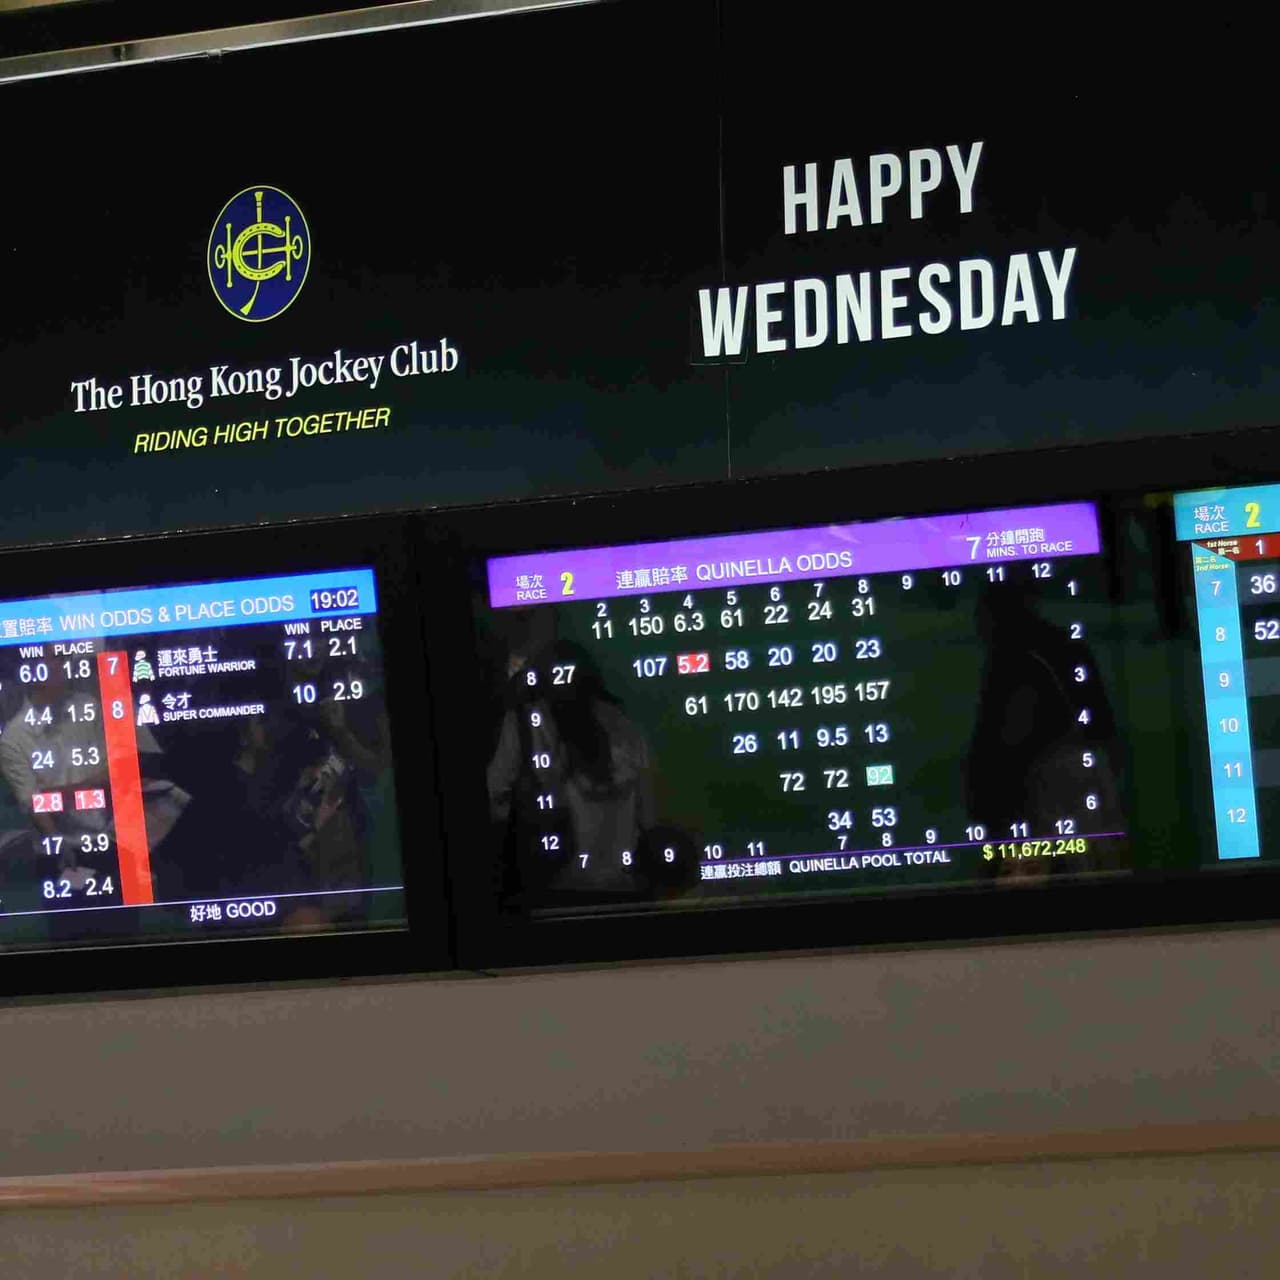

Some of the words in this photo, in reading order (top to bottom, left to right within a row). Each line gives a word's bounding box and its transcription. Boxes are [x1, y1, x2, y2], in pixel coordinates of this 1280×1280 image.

[783, 141, 984, 235] HAPPY
[699, 247, 1076, 357] WEDNESDAY
[71, 377, 123, 412] The
[130, 374, 203, 409] Hong
[210, 365, 282, 400] Kong
[285, 350, 385, 396] Jockey
[390, 338, 458, 377] Club
[134, 427, 208, 453] RIDING
[214, 420, 269, 444] HIGH
[275, 407, 390, 438] TOGETHER
[1245, 502, 1260, 527] 2
[986, 528, 1045, 547] 分鐘開跑
[1195, 521, 1229, 534] RACE
[966, 536, 981, 560] 7
[986, 546, 1018, 558] MINS.
[1021, 544, 1038, 554] TO
[1040, 541, 1072, 553] RACE
[516, 574, 544, 589] 場次
[560, 572, 574, 595] 2
[616, 565, 688, 589] 連贏賠率
[696, 557, 792, 580] QUINELLA
[797, 551, 852, 571] ODDS
[1251, 574, 1276, 594] 36
[517, 589, 547, 600] RACE
[60, 613, 95, 631] WIN
[100, 608, 153, 627] ODDS
[158, 606, 171, 622] &
[174, 600, 235, 621] PLACE
[240, 595, 294, 615] ODDS
[311, 589, 359, 609] 19:02
[19, 646, 43, 658] WIN
[54, 641, 94, 655] PLACE
[789, 856, 859, 873] QUINELLA
[862, 854, 901, 868] POOL
[904, 850, 951, 865] TOTAL
[983, 843, 993, 861] $
[998, 838, 1086, 860] 11,672,248
[190, 904, 222, 922] 好地
[226, 901, 276, 918] GOOD
